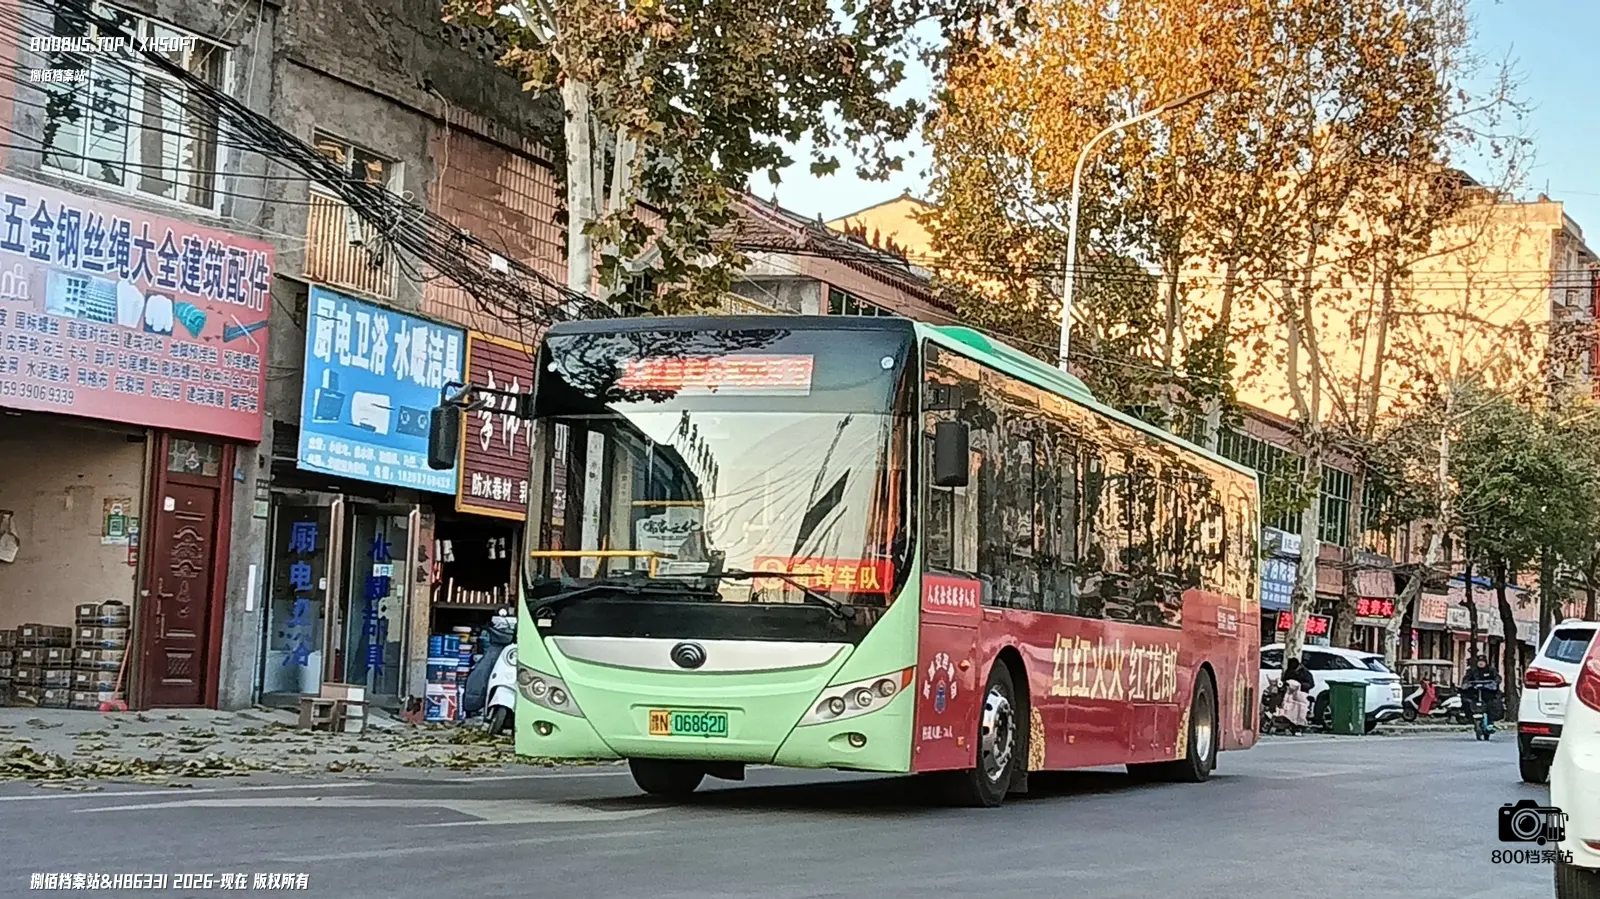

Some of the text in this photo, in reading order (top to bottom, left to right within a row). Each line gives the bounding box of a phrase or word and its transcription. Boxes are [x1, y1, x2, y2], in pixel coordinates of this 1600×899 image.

[1, 194, 270, 309] 五金钢丝绳大全建筑配件
[314, 297, 460, 389] 厨电卫浴 水暖洁具
[19, 383, 46, 401] 3906
[48, 387, 74, 405] 9339
[471, 473, 512, 502] 防水卷材
[282, 521, 319, 667] 厨电卫浴
[792, 563, 880, 590] 雷锋车队
[1052, 633, 1178, 702] 红红火火 红花郎
[675, 714, 726, 733] 06862D
